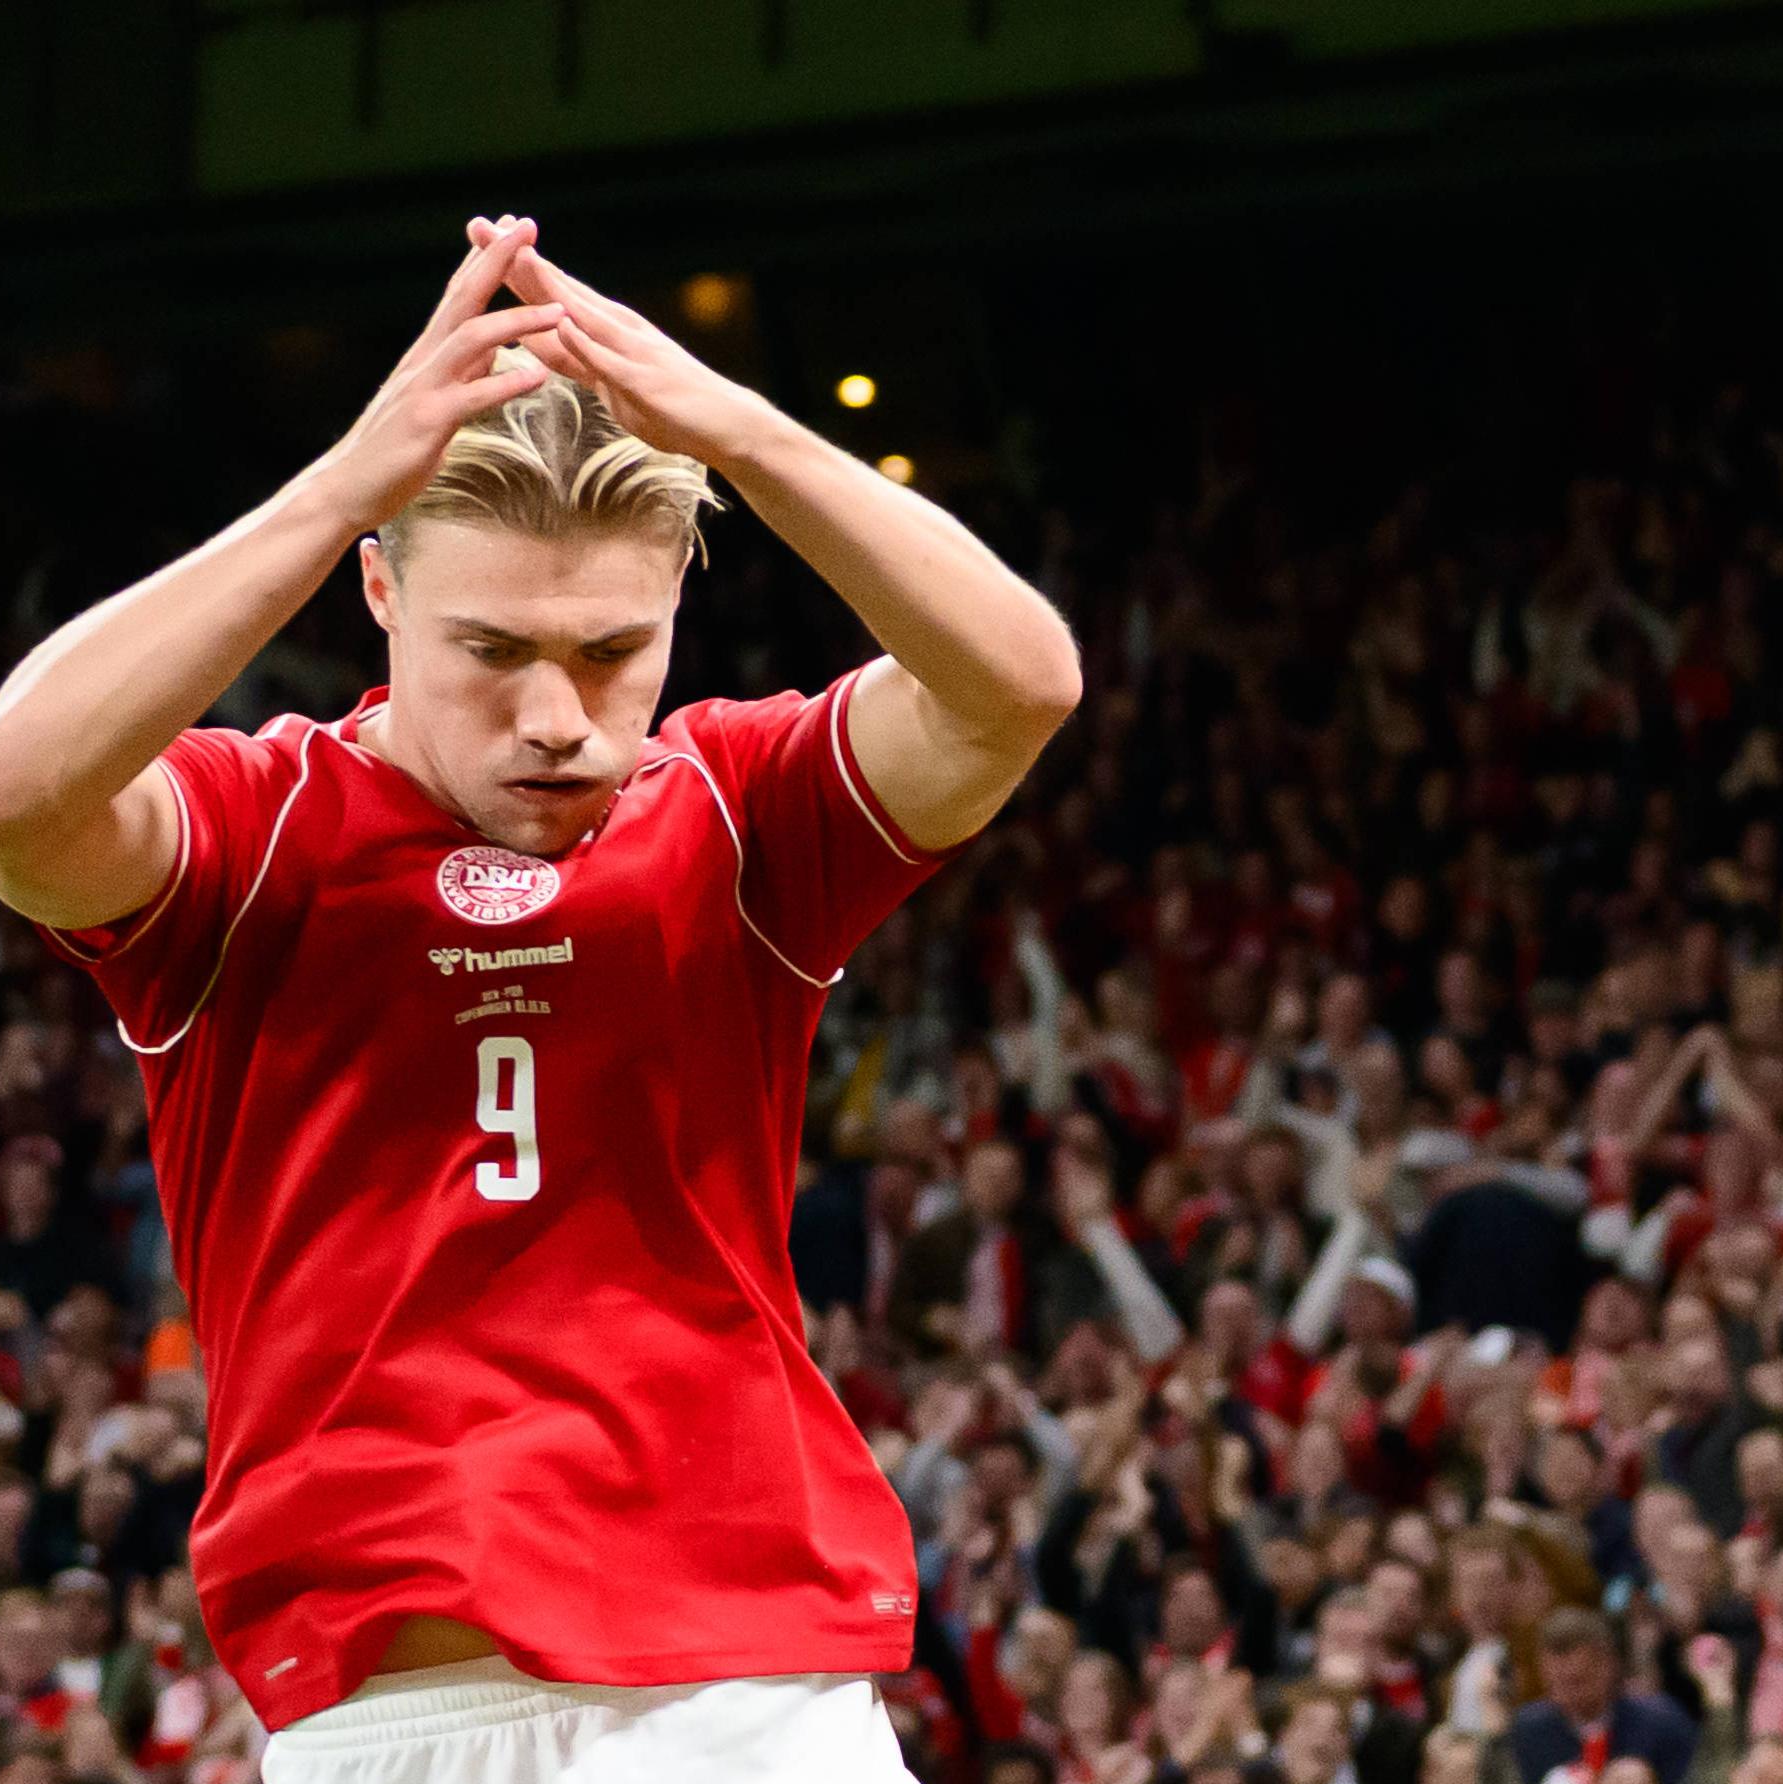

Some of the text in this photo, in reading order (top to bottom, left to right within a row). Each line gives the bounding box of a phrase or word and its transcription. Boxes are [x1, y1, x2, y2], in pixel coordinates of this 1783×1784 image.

[462, 864, 535, 892] DBU
[464, 936, 574, 973] hummel
[475, 1036, 541, 1201] 9
